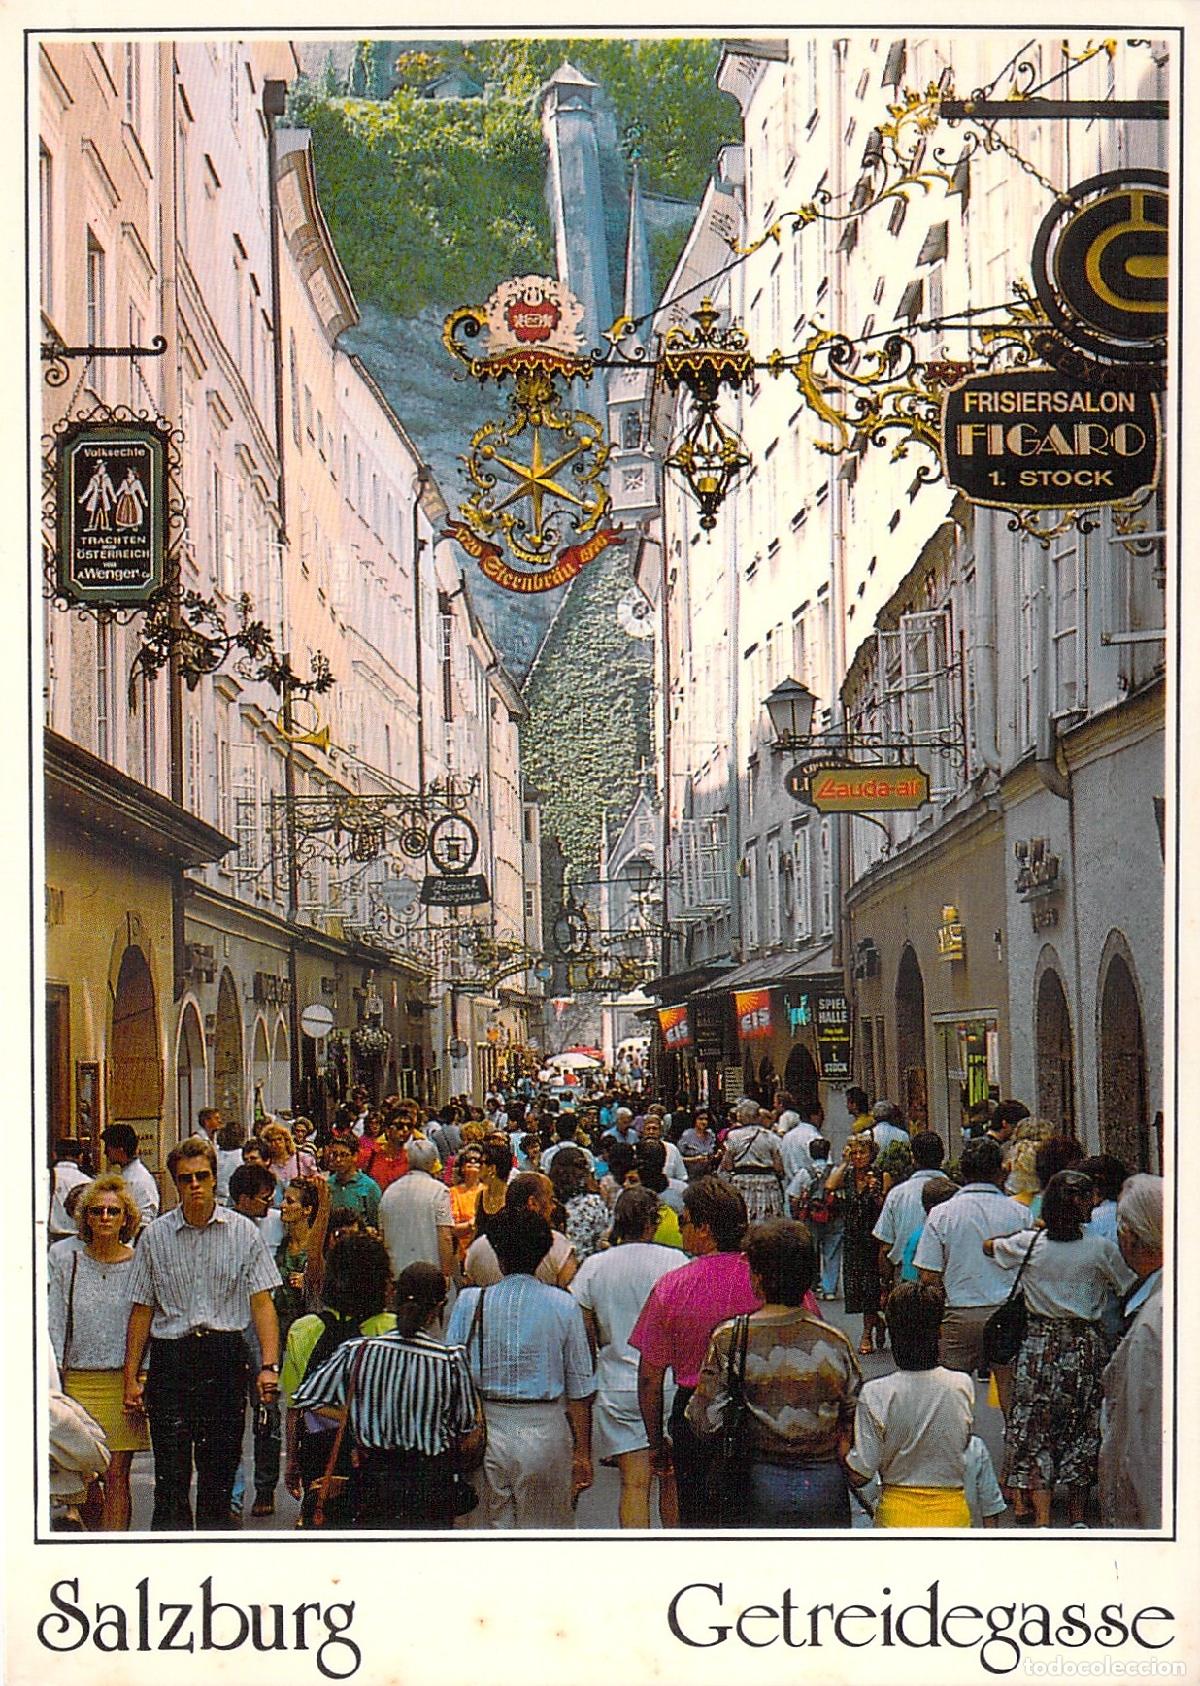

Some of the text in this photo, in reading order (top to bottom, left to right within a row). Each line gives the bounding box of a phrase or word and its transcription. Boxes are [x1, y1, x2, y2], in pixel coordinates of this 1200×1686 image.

[964, 391, 1135, 413] FRISIERSALON
[956, 423, 1146, 457] FIGARO
[987, 470, 1113, 486] 1. STOCK
[80, 535, 147, 545] TRACHTEN
[76, 547, 150, 560] ÖSTERREICH
[483, 555, 577, 591] Sternbräu
[819, 998, 847, 1010] SPIEL
